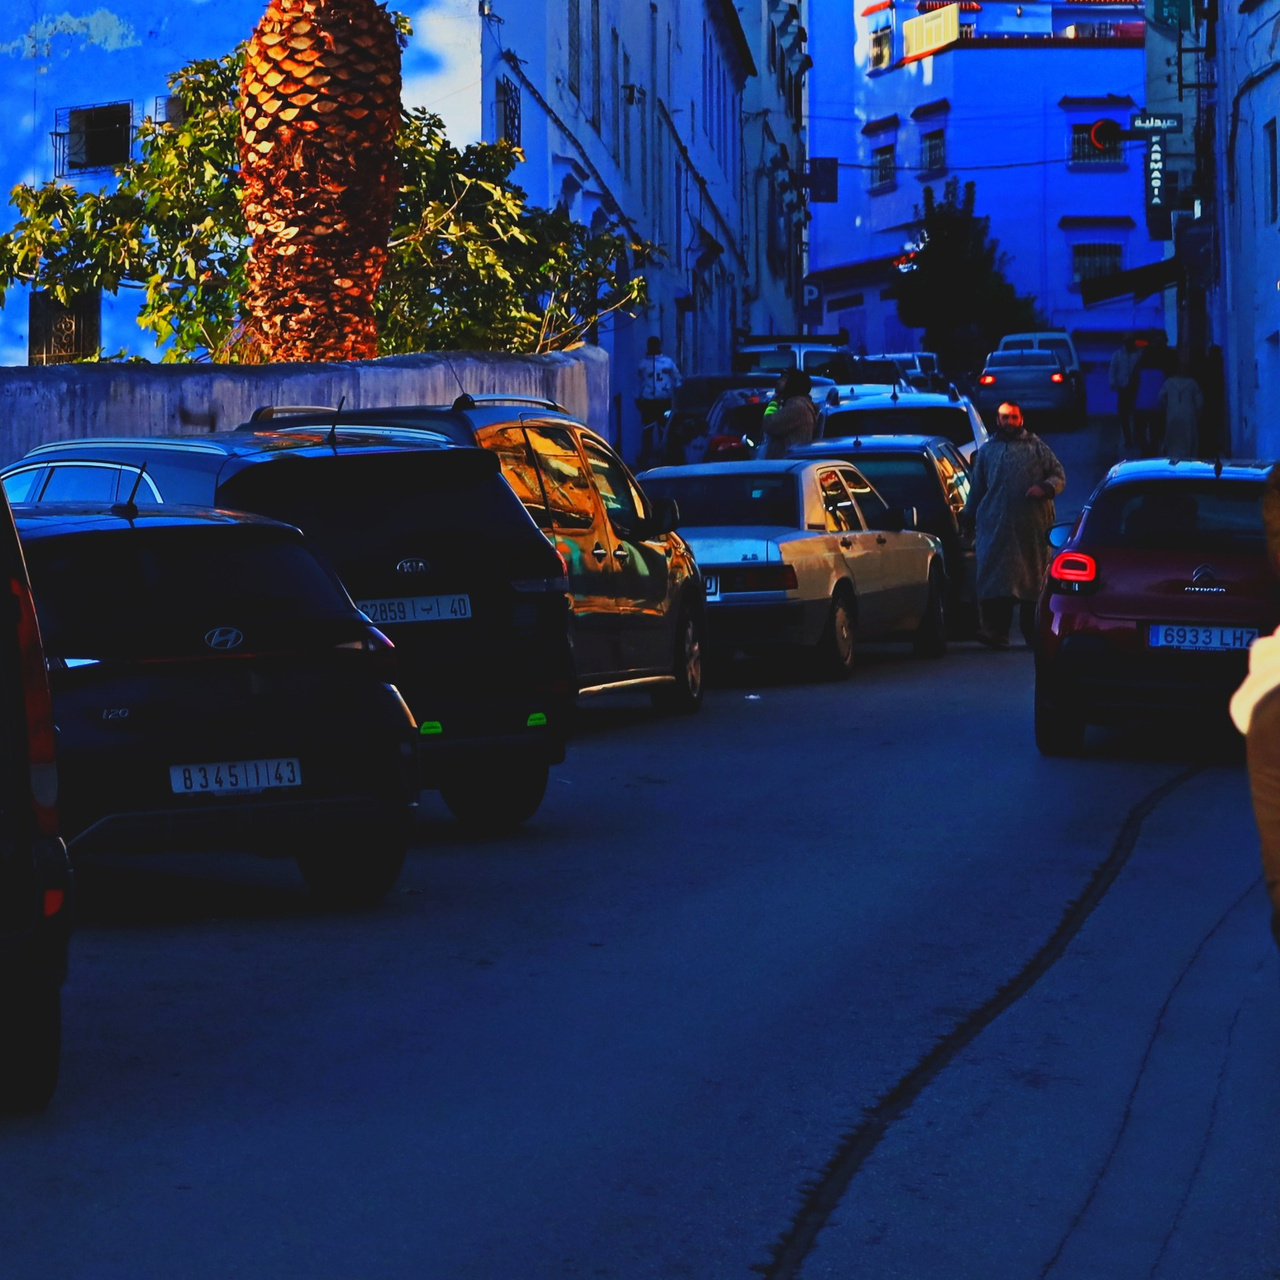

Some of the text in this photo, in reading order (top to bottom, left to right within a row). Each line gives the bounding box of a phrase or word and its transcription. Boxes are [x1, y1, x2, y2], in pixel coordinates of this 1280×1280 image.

[1134, 116, 1177, 129] صيدلية
[1149, 135, 1163, 205] FARMACIA
[803, 285, 819, 306] P
[402, 562, 426, 573] KIA
[450, 598, 467, 617] 40
[1163, 627, 1213, 646] 6933
[182, 764, 239, 790] 8345
[274, 762, 297, 784] 43
